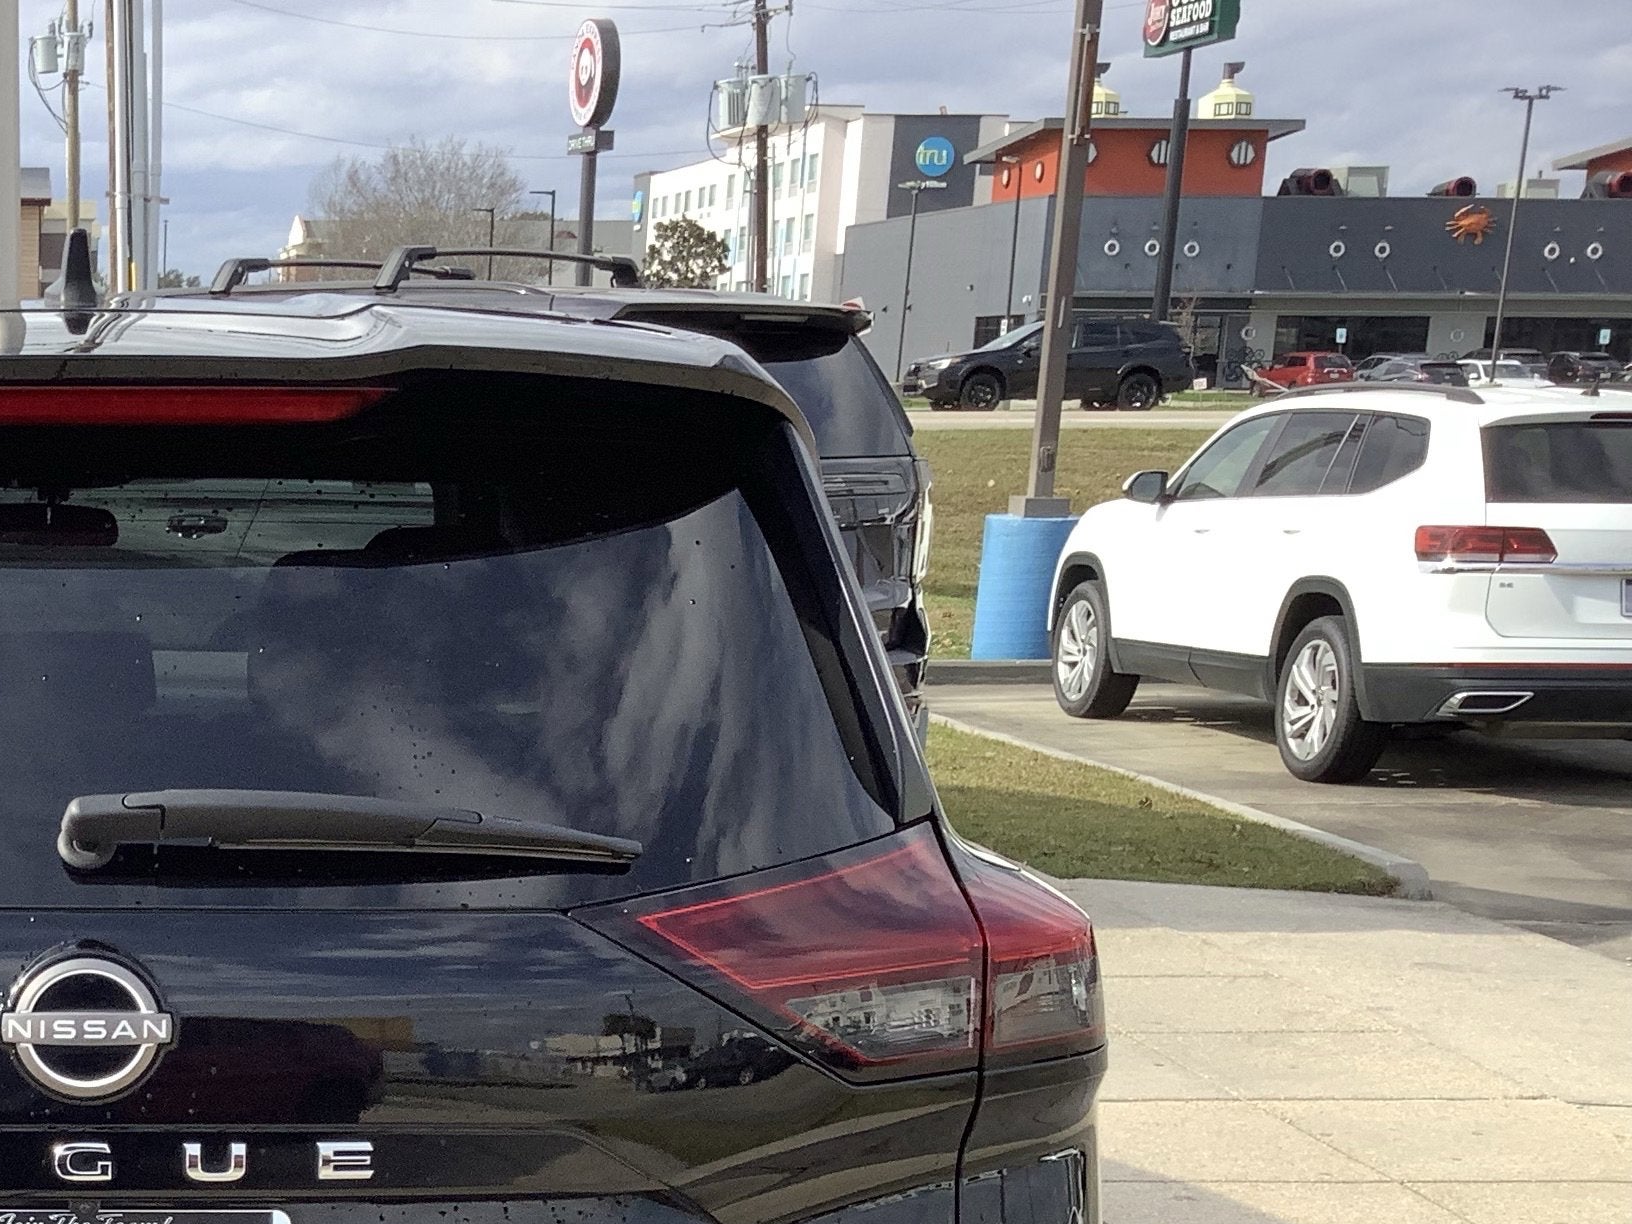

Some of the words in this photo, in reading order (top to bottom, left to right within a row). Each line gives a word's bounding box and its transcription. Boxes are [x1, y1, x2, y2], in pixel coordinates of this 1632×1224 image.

[1170, 0, 1212, 27] SEAFOOD
[918, 144, 947, 166] tru
[7, 1019, 167, 1039] NISSAN
